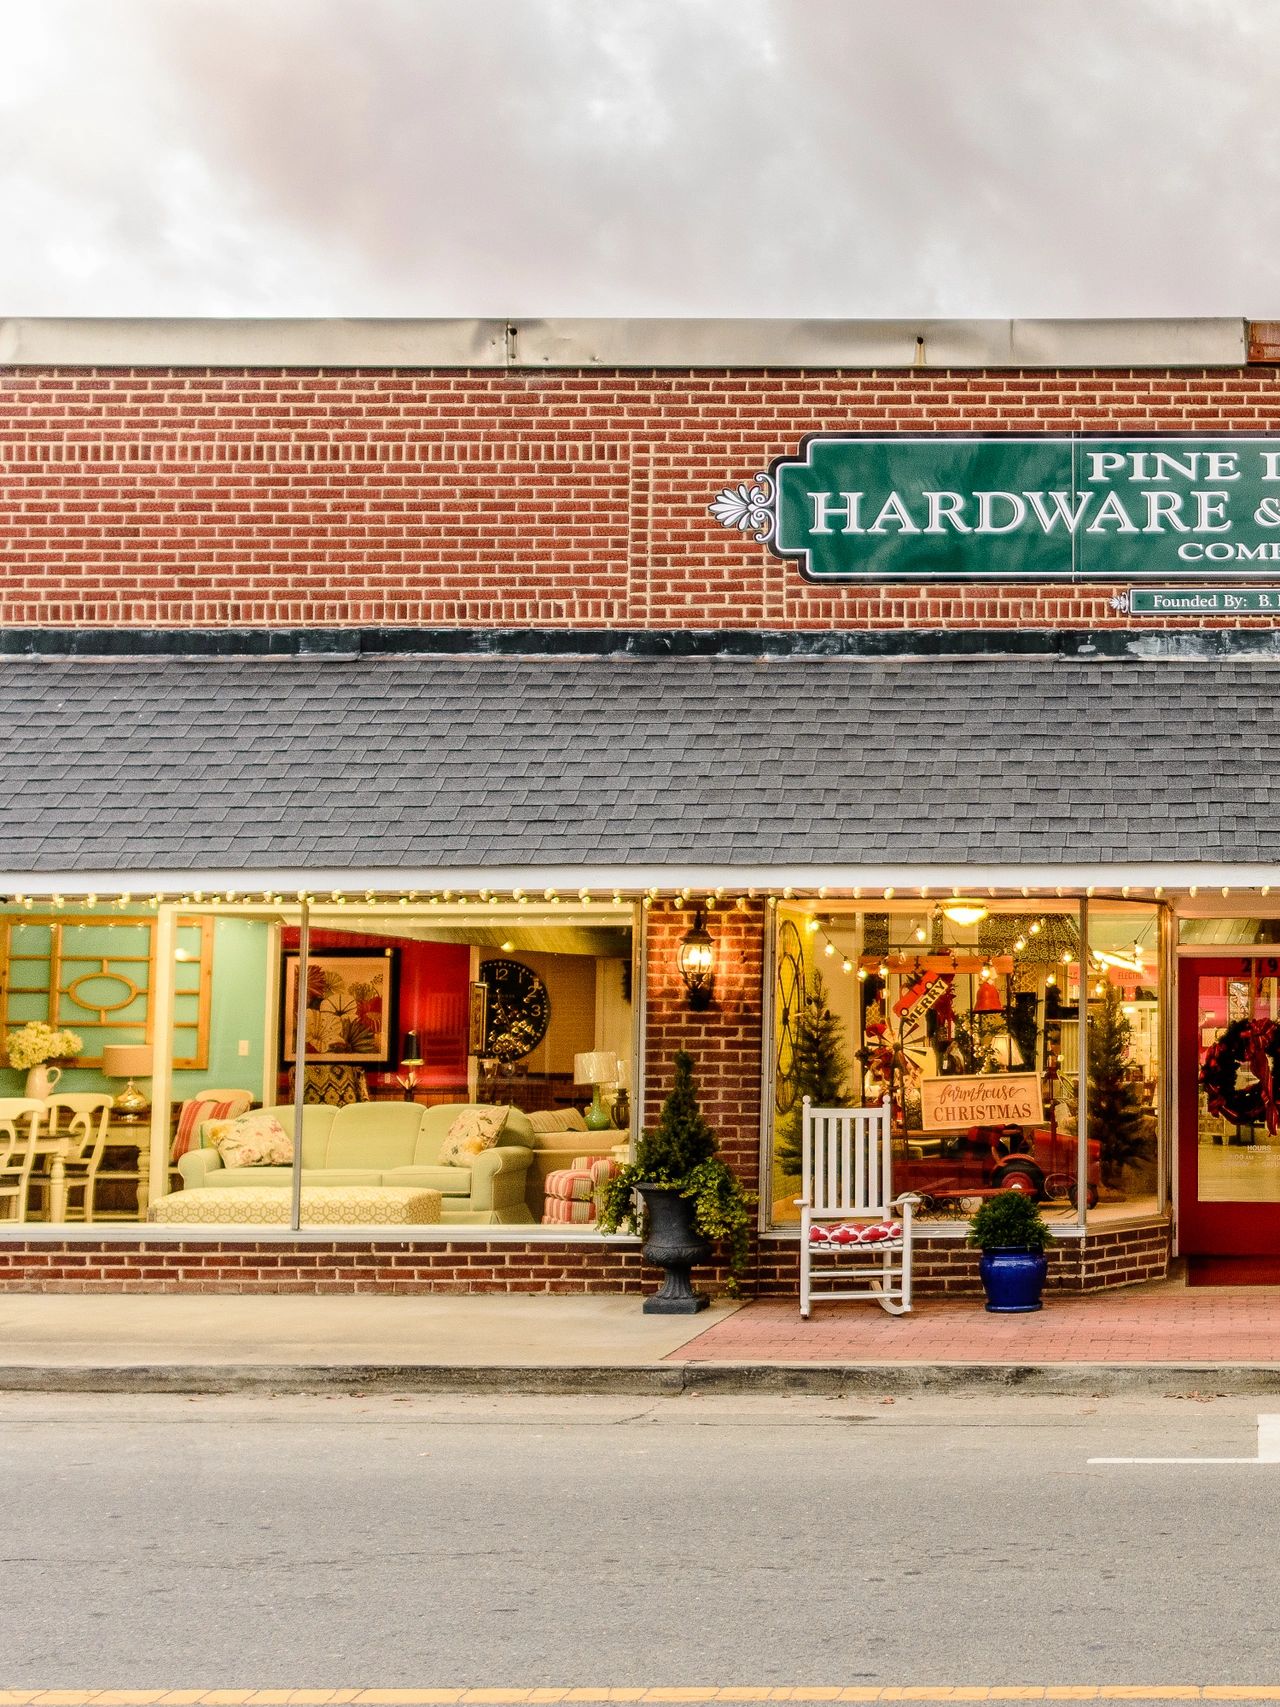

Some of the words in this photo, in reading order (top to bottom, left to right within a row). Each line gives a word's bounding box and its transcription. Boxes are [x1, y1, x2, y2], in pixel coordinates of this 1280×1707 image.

[1086, 451, 1241, 482] PINE
[806, 490, 1232, 535] HARDWARE
[1153, 594, 1218, 607] Founded
[1223, 594, 1247, 610] By:
[1258, 593, 1273, 607] B.
[496, 968, 508, 981] 12
[527, 985, 538, 998] 2
[531, 1004, 541, 1017] 3
[904, 980, 947, 1027] MERRY
[937, 1082, 1027, 1105] farmhouse
[933, 1102, 1032, 1123] CHRISTMAS
